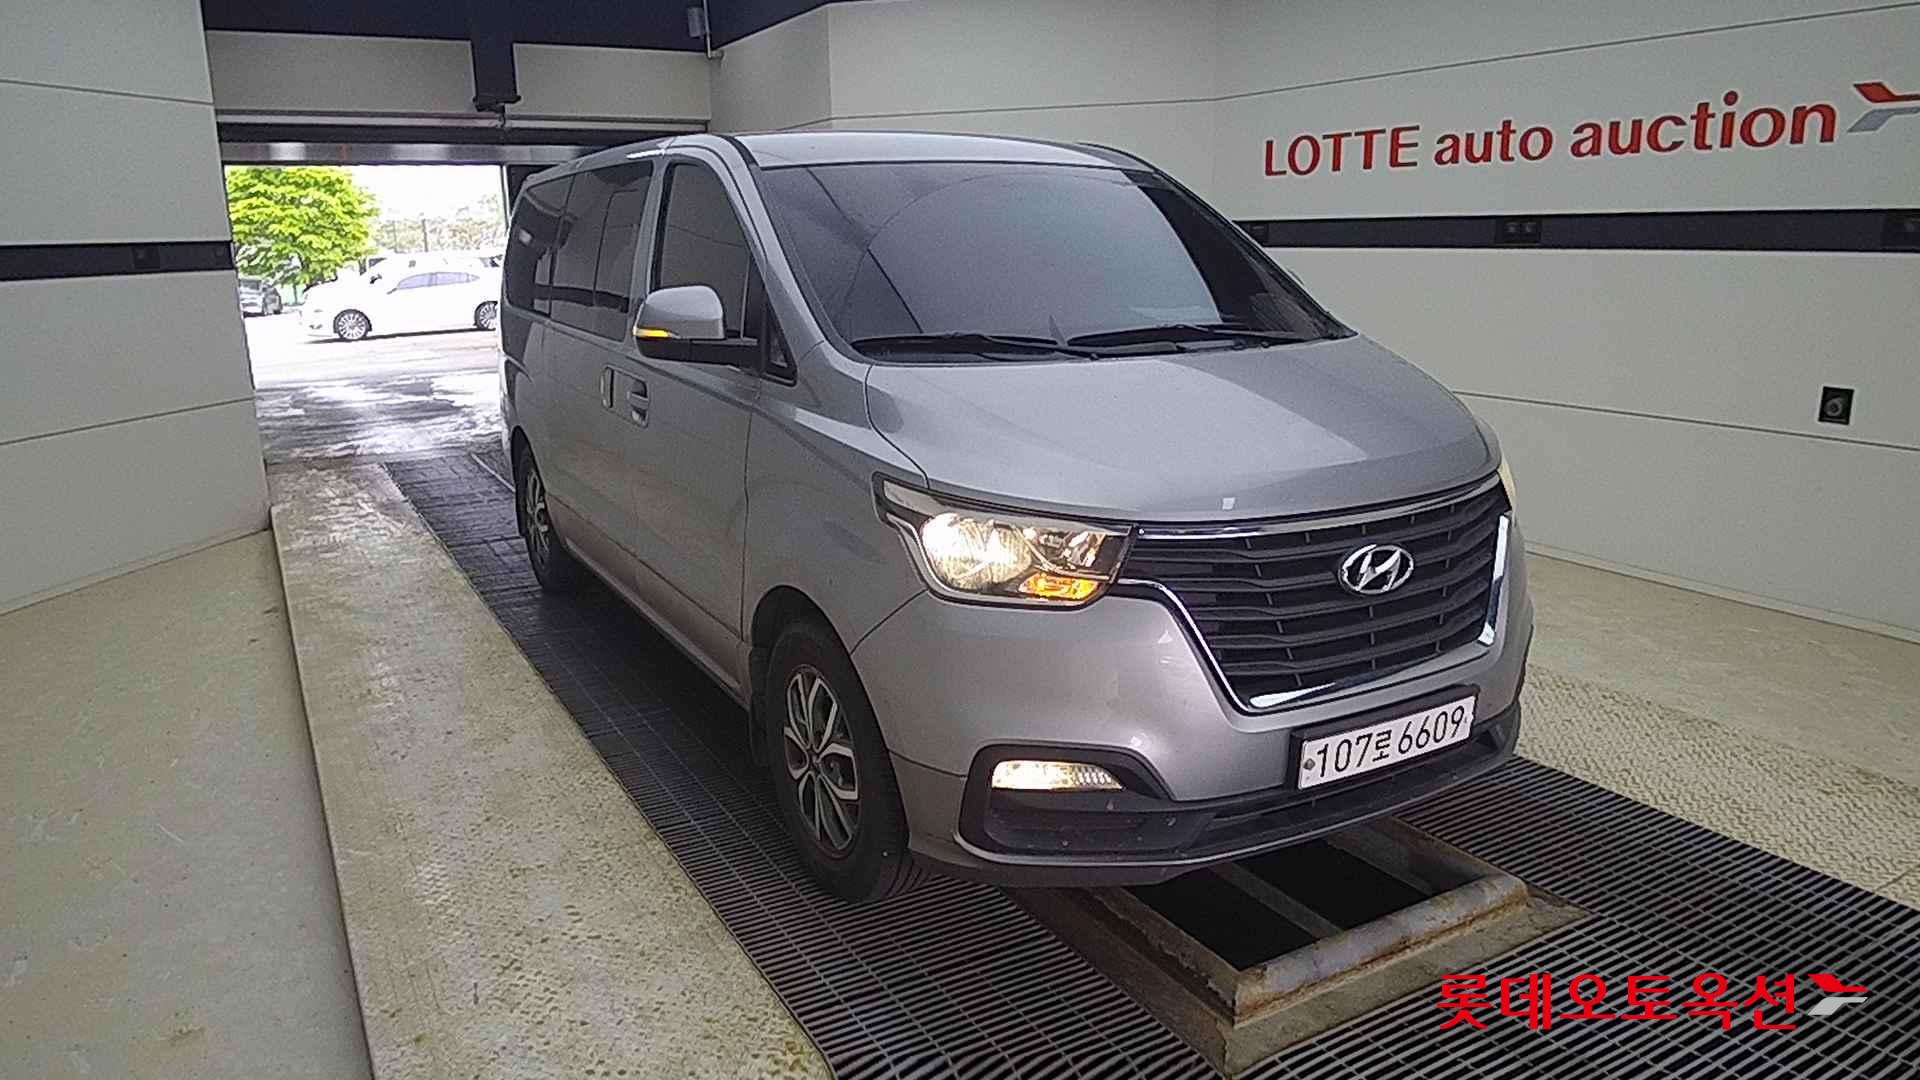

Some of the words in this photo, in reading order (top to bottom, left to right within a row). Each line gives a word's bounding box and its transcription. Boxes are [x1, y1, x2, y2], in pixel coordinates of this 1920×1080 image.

[1264, 125, 1420, 177] LOTTE
[1434, 120, 1554, 165] auto
[1571, 91, 1838, 158] auction
